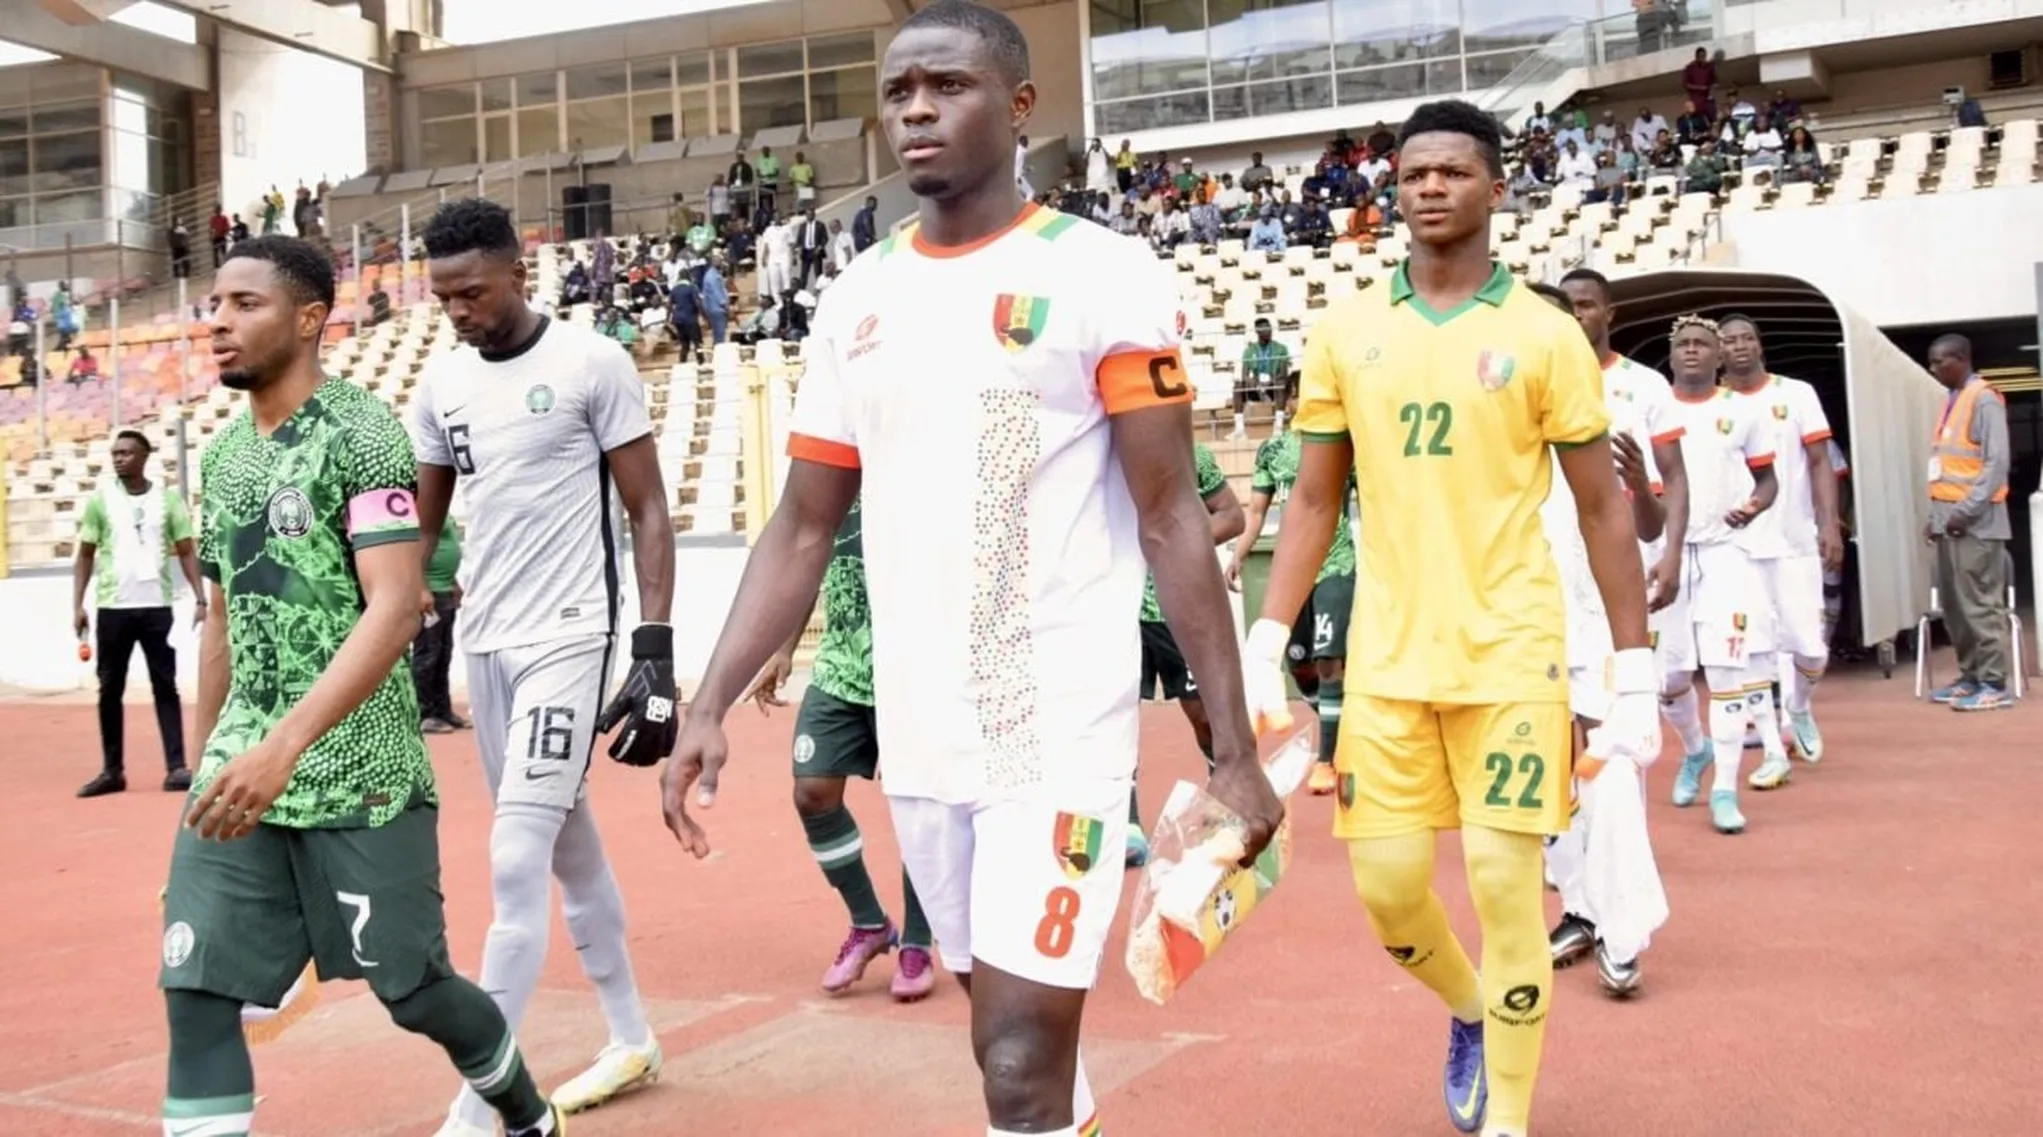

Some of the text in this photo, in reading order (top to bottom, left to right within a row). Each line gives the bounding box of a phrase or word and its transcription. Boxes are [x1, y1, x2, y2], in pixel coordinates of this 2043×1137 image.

[1149, 356, 1187, 398] C
[442, 424, 476, 475] 6
[1400, 402, 1453, 457] 22
[386, 492, 409, 517] C
[1315, 613, 1333, 641] 14
[527, 706, 575, 760] 16
[1485, 752, 1544, 808] 22
[336, 890, 371, 952] 7
[1034, 886, 1081, 959] 8
